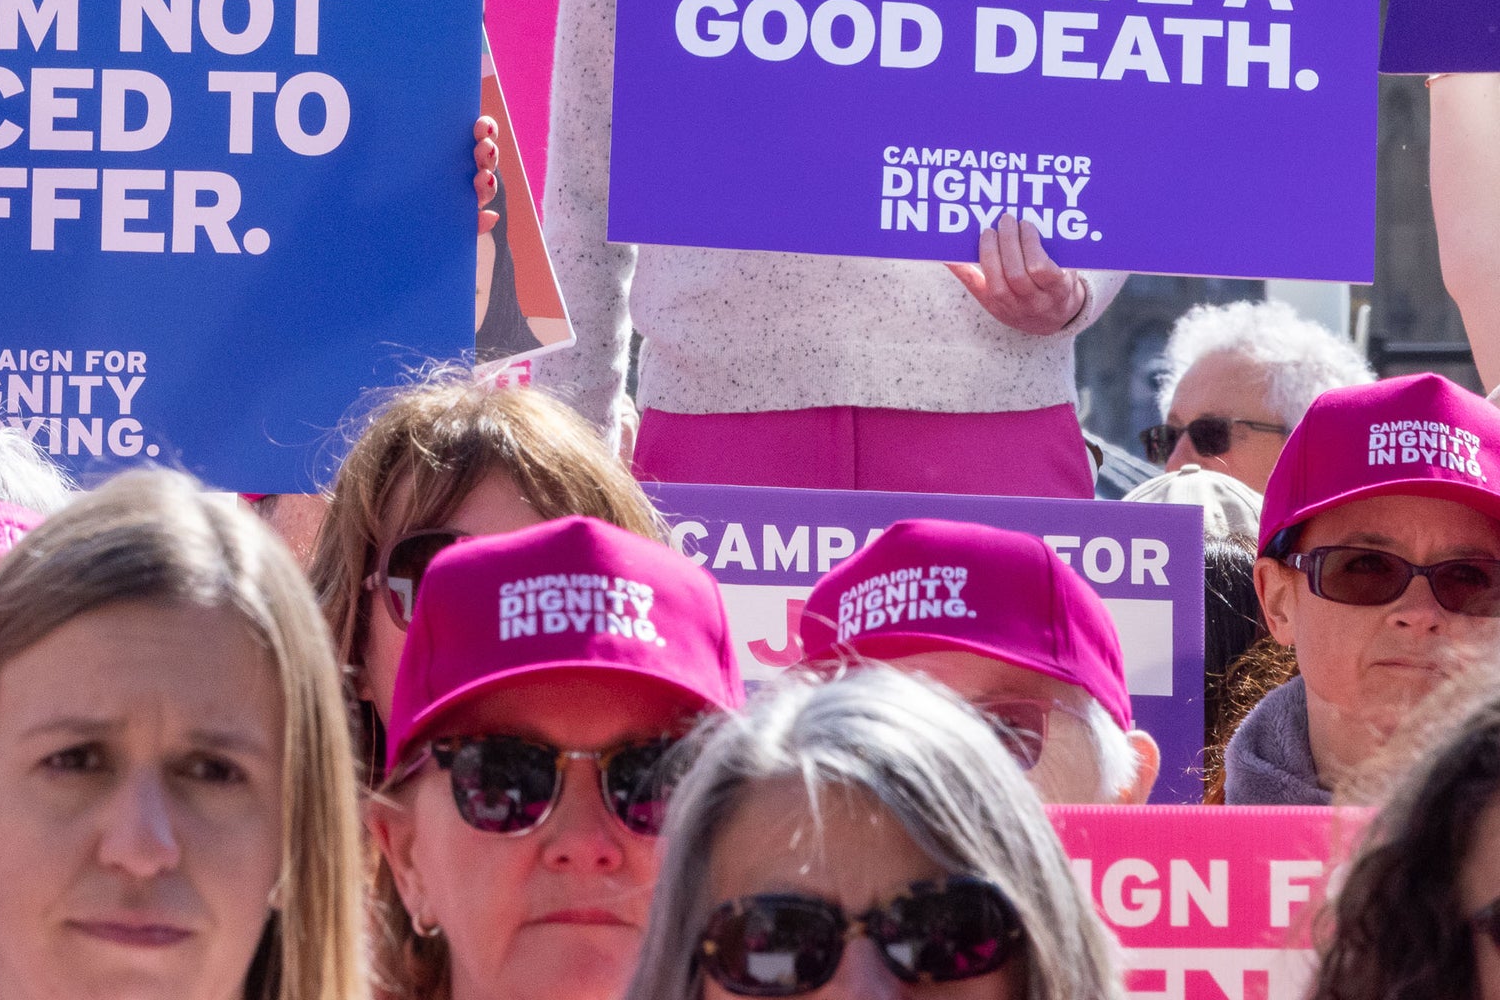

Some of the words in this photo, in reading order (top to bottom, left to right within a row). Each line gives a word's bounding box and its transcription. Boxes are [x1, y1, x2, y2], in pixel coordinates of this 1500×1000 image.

[974, 7, 1320, 91] DEATH.
[208, 70, 352, 156] TO
[883, 146, 1027, 171] CAMPAIGN
[1037, 154, 1092, 175] FOR
[881, 166, 1091, 207] DIGNITY
[880, 199, 929, 232] IN
[938, 203, 1103, 241] DYNG.
[85, 350, 147, 373] FOR
[1368, 431, 1480, 460] DIGNITY
[1369, 420, 1450, 435] CAMPAIGN
[1454, 427, 1480, 448] FOR
[1368, 449, 1396, 466] IN
[1401, 447, 1487, 483] DYING.
[671, 521, 884, 573] CAMP
[499, 574, 609, 595] CAMPAIGN
[614, 577, 654, 598] FOR
[838, 579, 967, 625] DIGNITY
[839, 567, 923, 605] CAMPAIGN
[929, 566, 969, 580] FOR
[499, 589, 654, 620] DIGNITY
[837, 616, 862, 644] IN
[865, 598, 977, 630] DYING.
[499, 614, 537, 641] IN
[542, 611, 667, 647] DYING.
